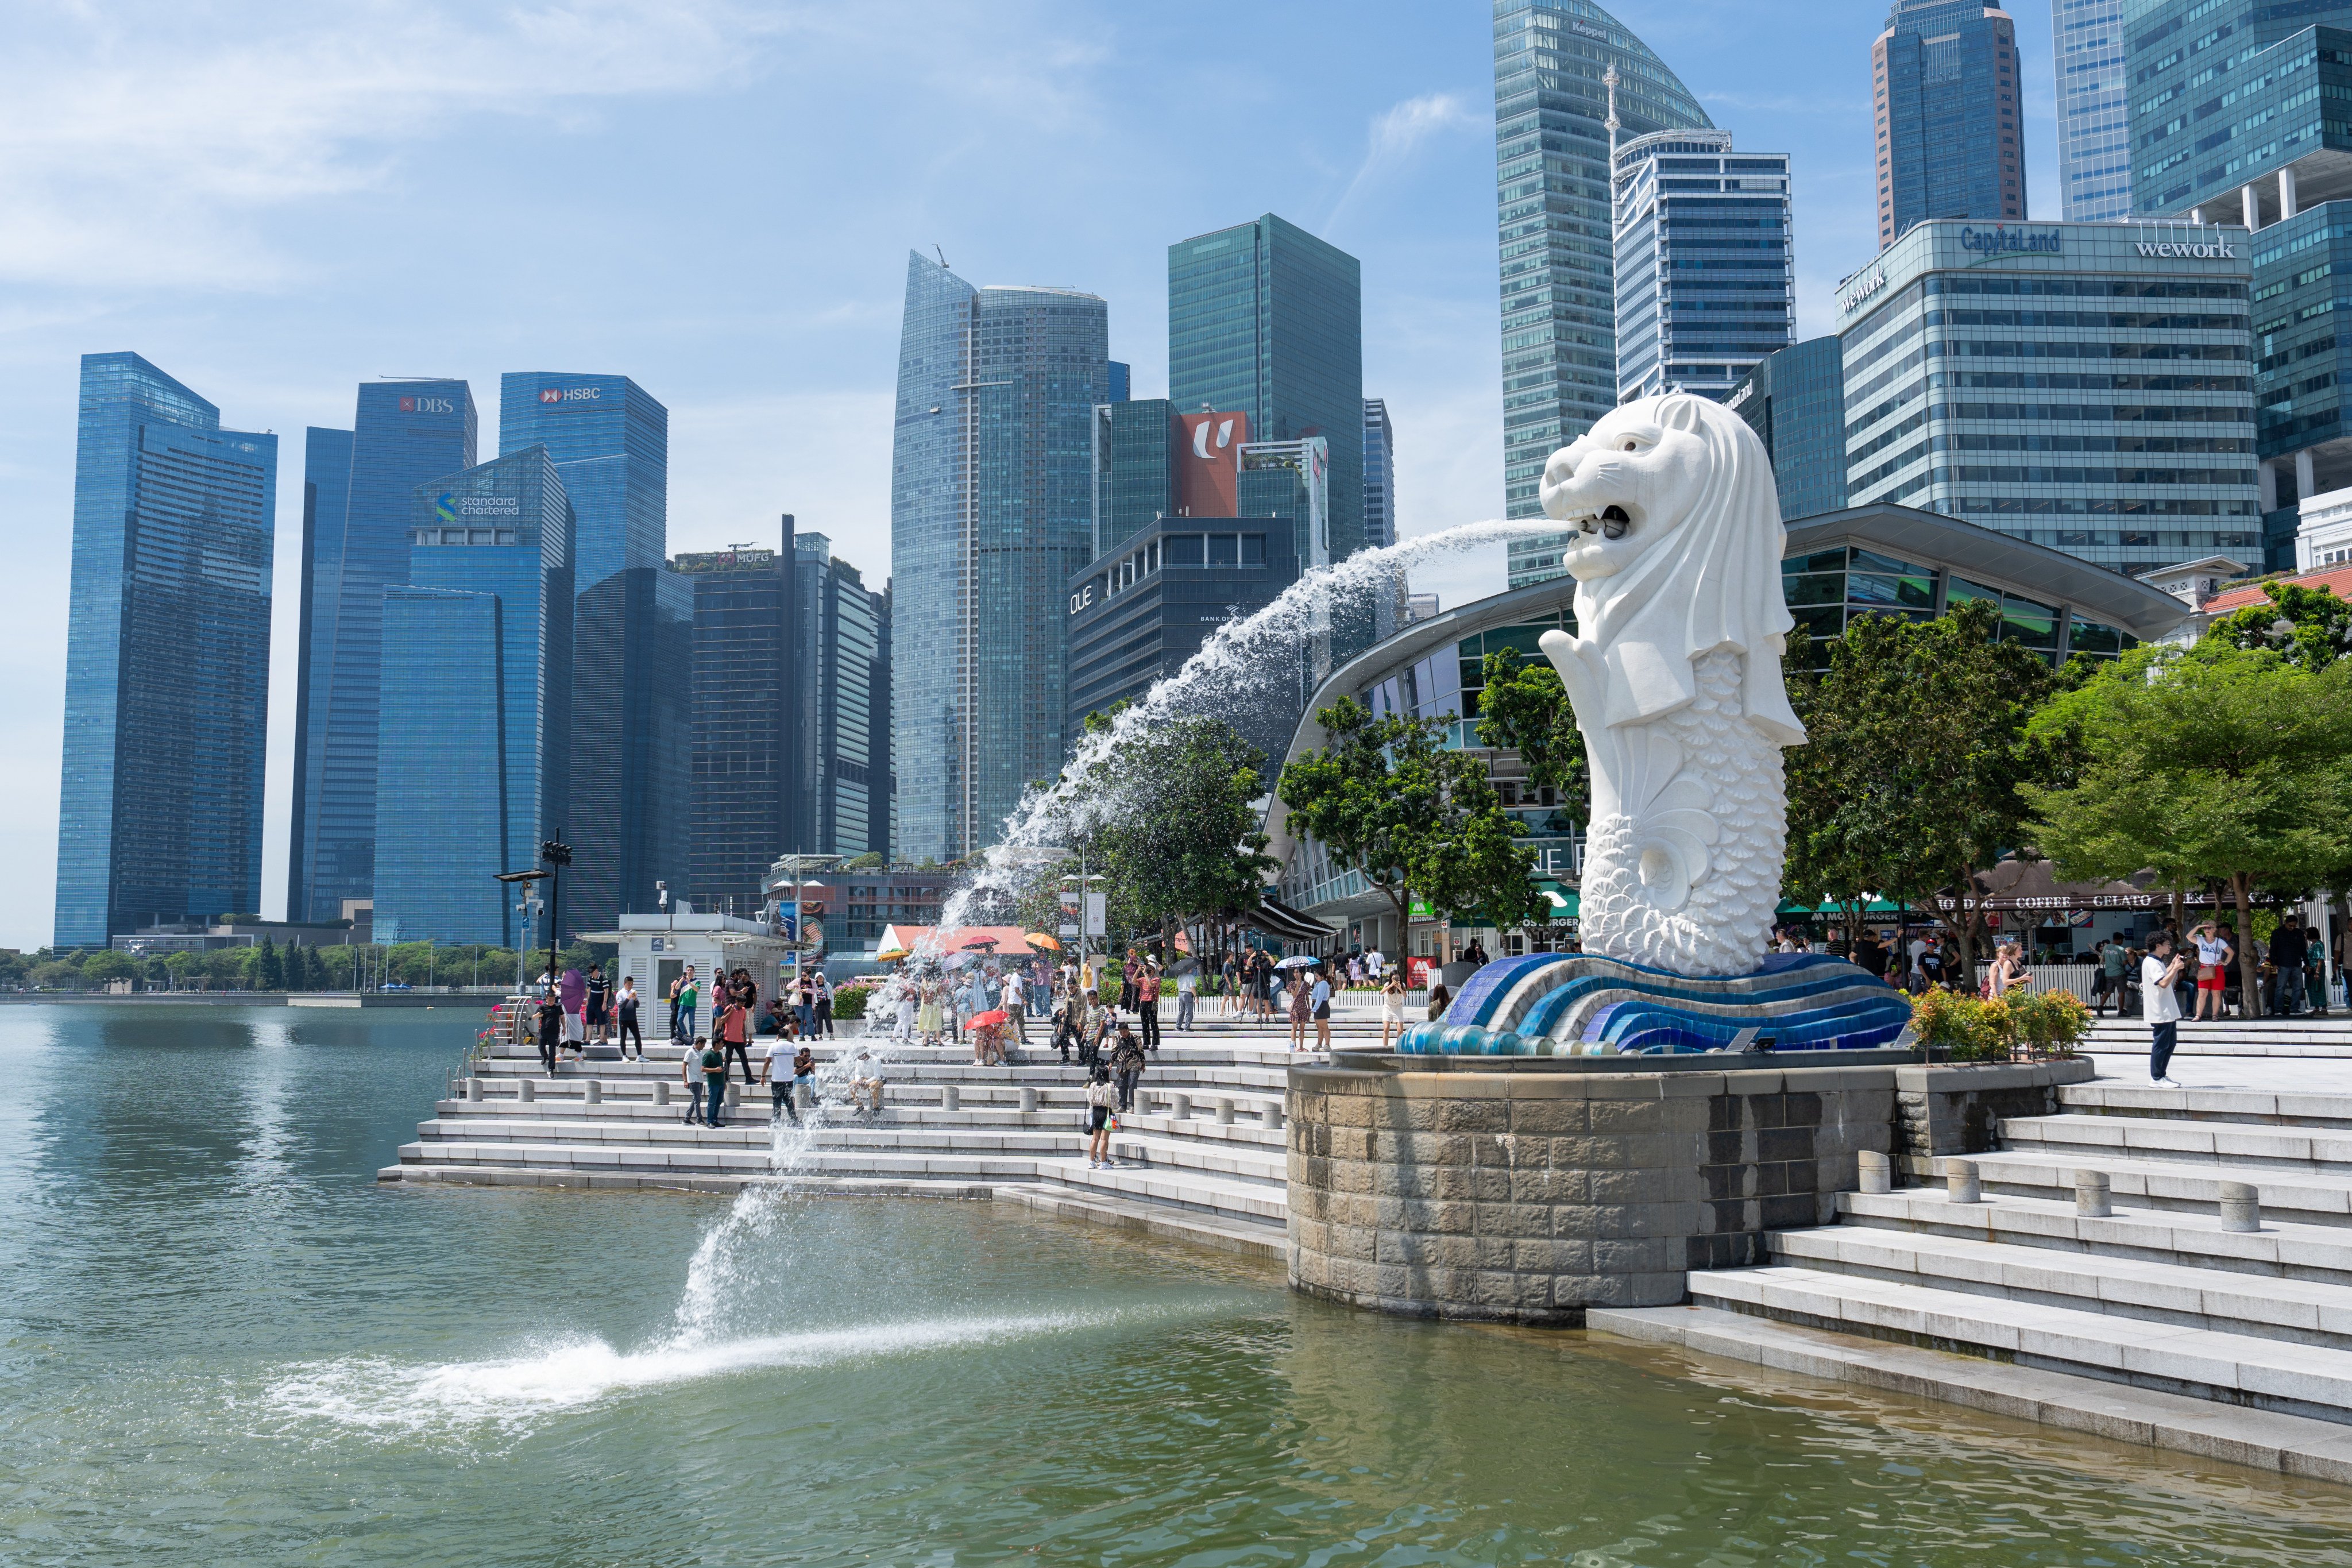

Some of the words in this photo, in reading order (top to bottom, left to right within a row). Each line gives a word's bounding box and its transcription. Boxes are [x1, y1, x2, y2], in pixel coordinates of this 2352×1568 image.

[1573, 21, 1606, 39] Keppel
[1961, 223, 2060, 256] CapitaLand
[2134, 235, 2237, 258] wework
[1841, 264, 1884, 313] wework
[563, 388, 600, 400] HSBC
[417, 397, 453, 414] DBS
[462, 496, 516, 505] standard
[462, 506, 519, 515] chartered
[737, 553, 769, 562] MUFG
[1071, 585, 1092, 615] OUE
[2016, 897, 2071, 908] COFFEE
[2093, 895, 2151, 906] GELATO
[1827, 912, 1846, 920] MO
[1520, 919, 1537, 927] OS
